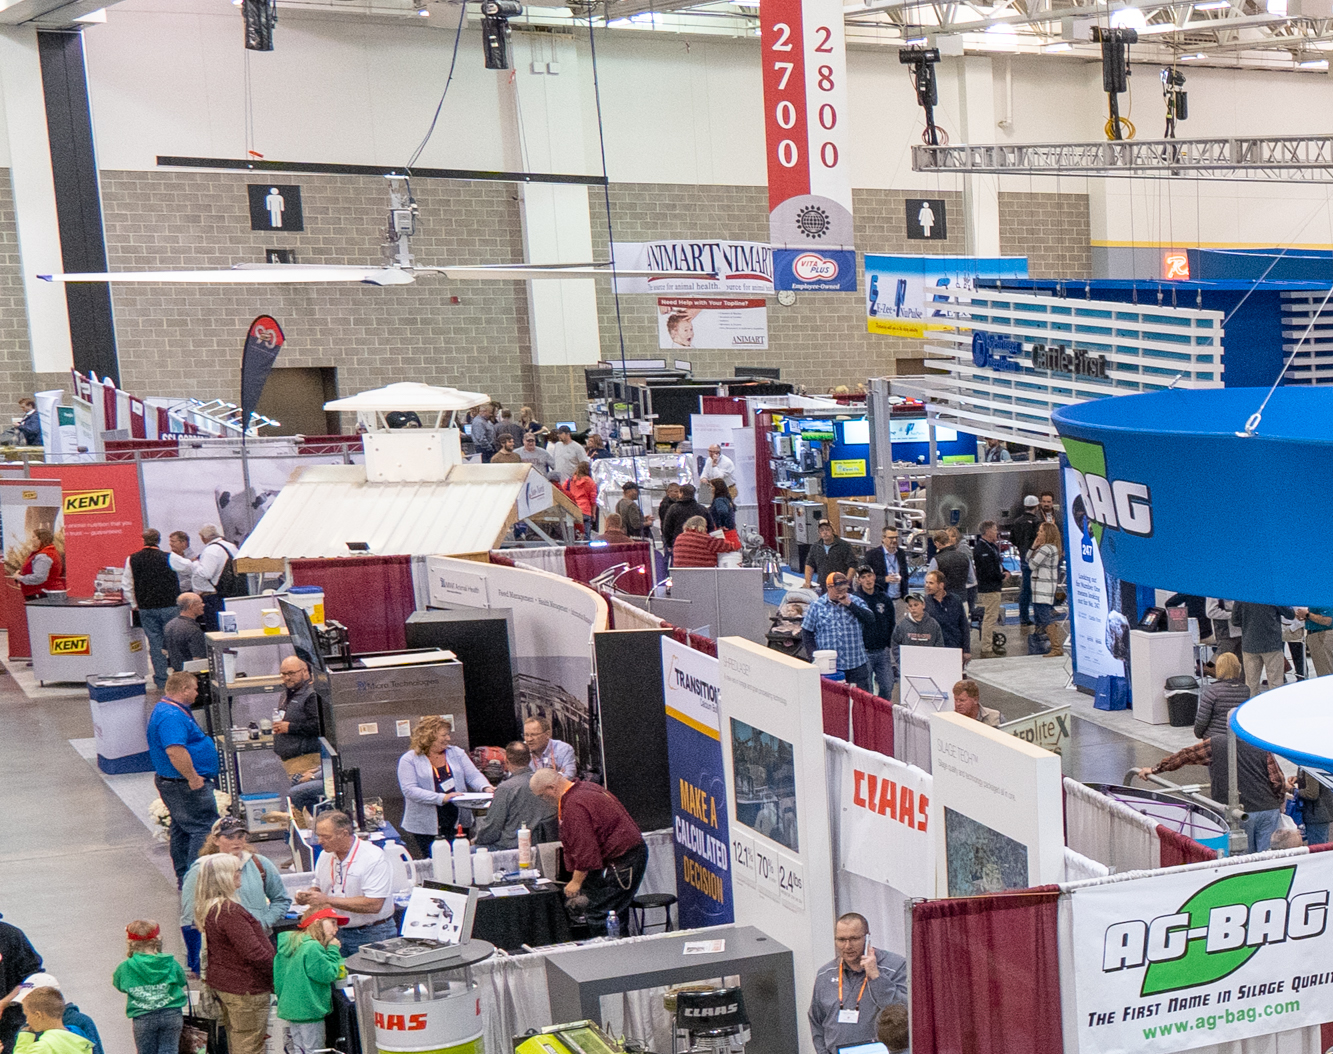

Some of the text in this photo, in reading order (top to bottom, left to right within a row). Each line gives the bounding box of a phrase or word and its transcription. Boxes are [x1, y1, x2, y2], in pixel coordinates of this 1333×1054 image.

[772, 23, 798, 168] 2700
[815, 26, 839, 168] 2800
[800, 260, 819, 268] VITA
[810, 266, 830, 274] PLUS
[722, 300, 748, 308] Topline?
[1032, 344, 1070, 373] Cattle
[66, 493, 109, 511] KENT
[1082, 544, 1092, 556] 247
[53, 638, 87, 651] KENT
[674, 667, 722, 702] TRANSITION
[679, 778, 719, 830] MAKE A
[853, 768, 930, 833] CLAAS
[675, 815, 728, 871] CALCULATED
[683, 855, 724, 905] DECISION
[1102, 889, 1330, 974] AG-BAG
[684, 1003, 738, 1018] CLAAS
[1088, 1011, 1116, 1028] THE
[1122, 1003, 1162, 1022] FIRST
[1168, 993, 1211, 1014] NAME
[1237, 980, 1284, 1001] SILAGE
[1142, 1000, 1301, 1041] www.ag-bag.com
